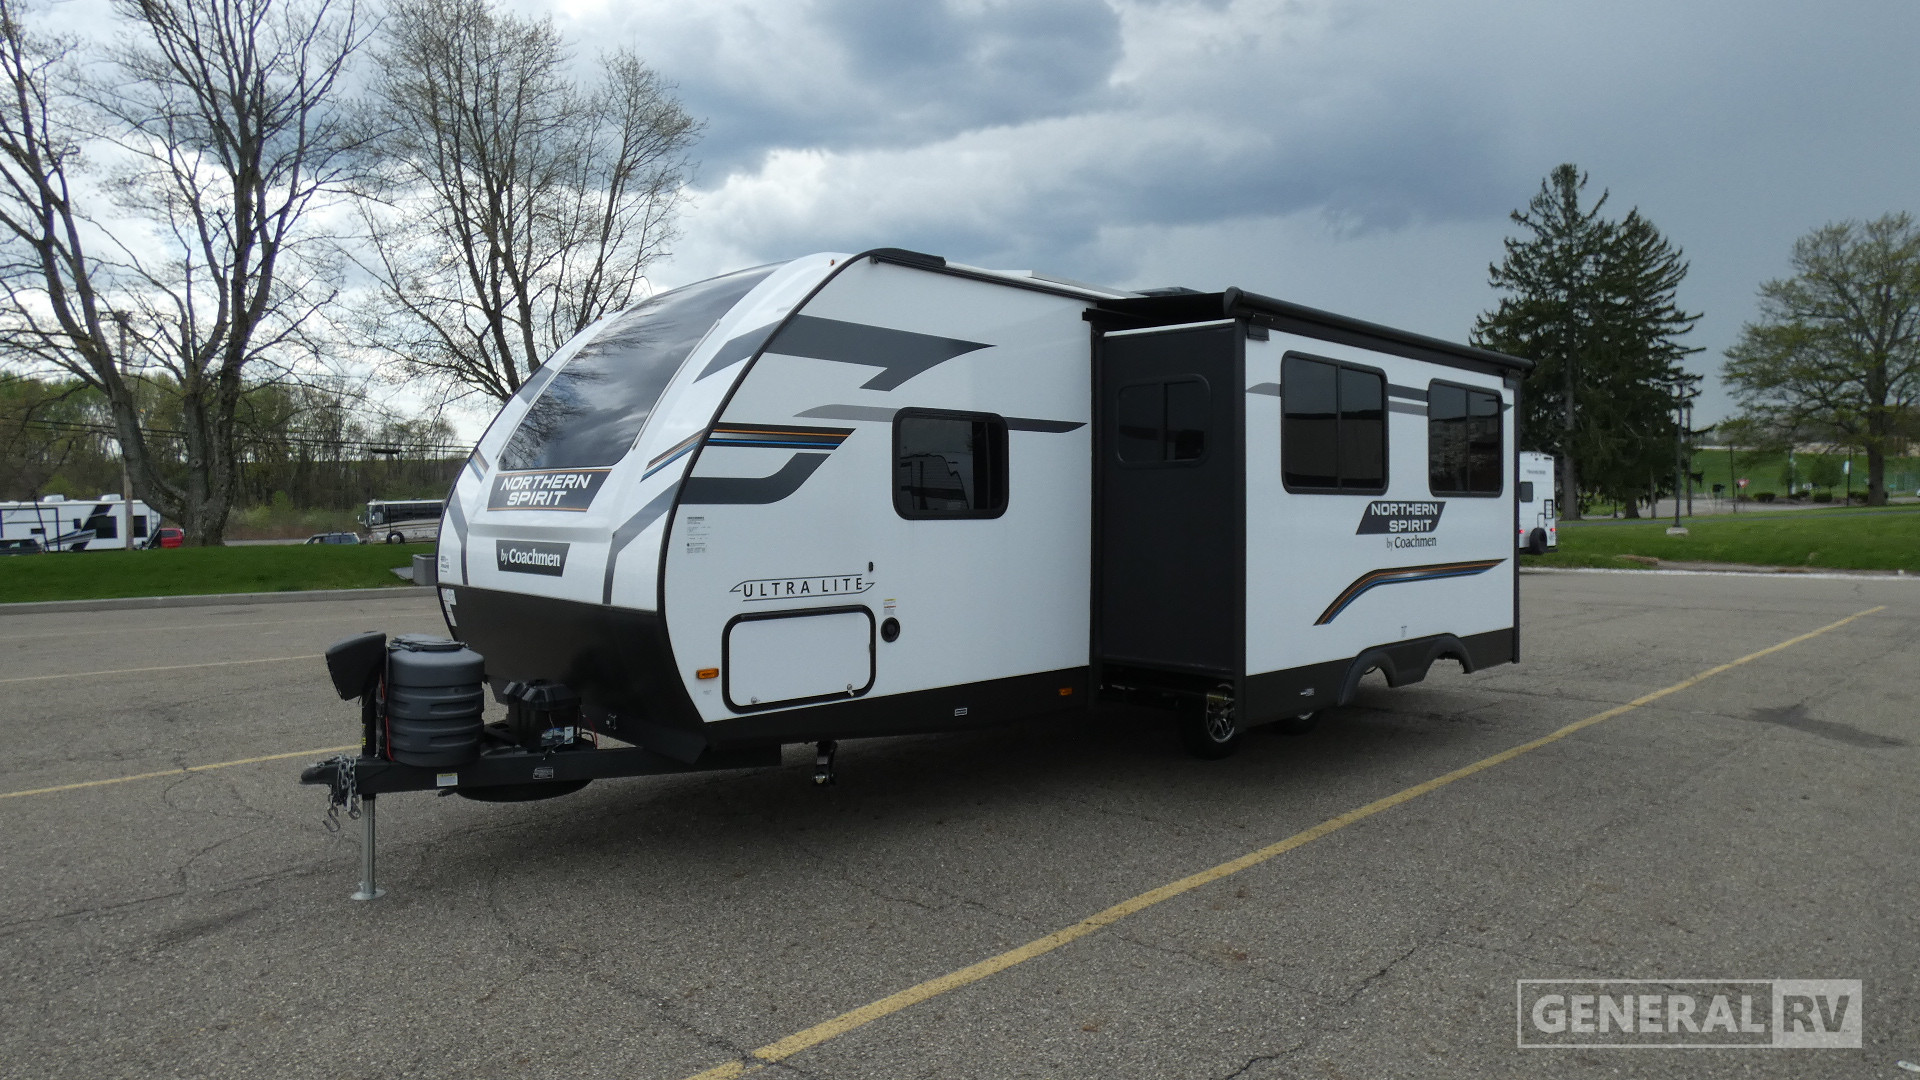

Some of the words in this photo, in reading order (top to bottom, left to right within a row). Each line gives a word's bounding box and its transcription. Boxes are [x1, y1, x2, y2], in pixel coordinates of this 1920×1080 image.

[500, 474, 592, 491] NORTHERN
[506, 490, 567, 506] SPIRIT
[1371, 503, 1438, 516] NORTHERN
[1388, 519, 1432, 533] SPIRIT
[1386, 537, 1393, 552] by
[1394, 534, 1437, 549] Coachmen
[500, 548, 509, 565] by
[508, 548, 561, 567] Coachmen
[743, 580, 811, 598] ULTRA
[821, 577, 863, 593] LITE
